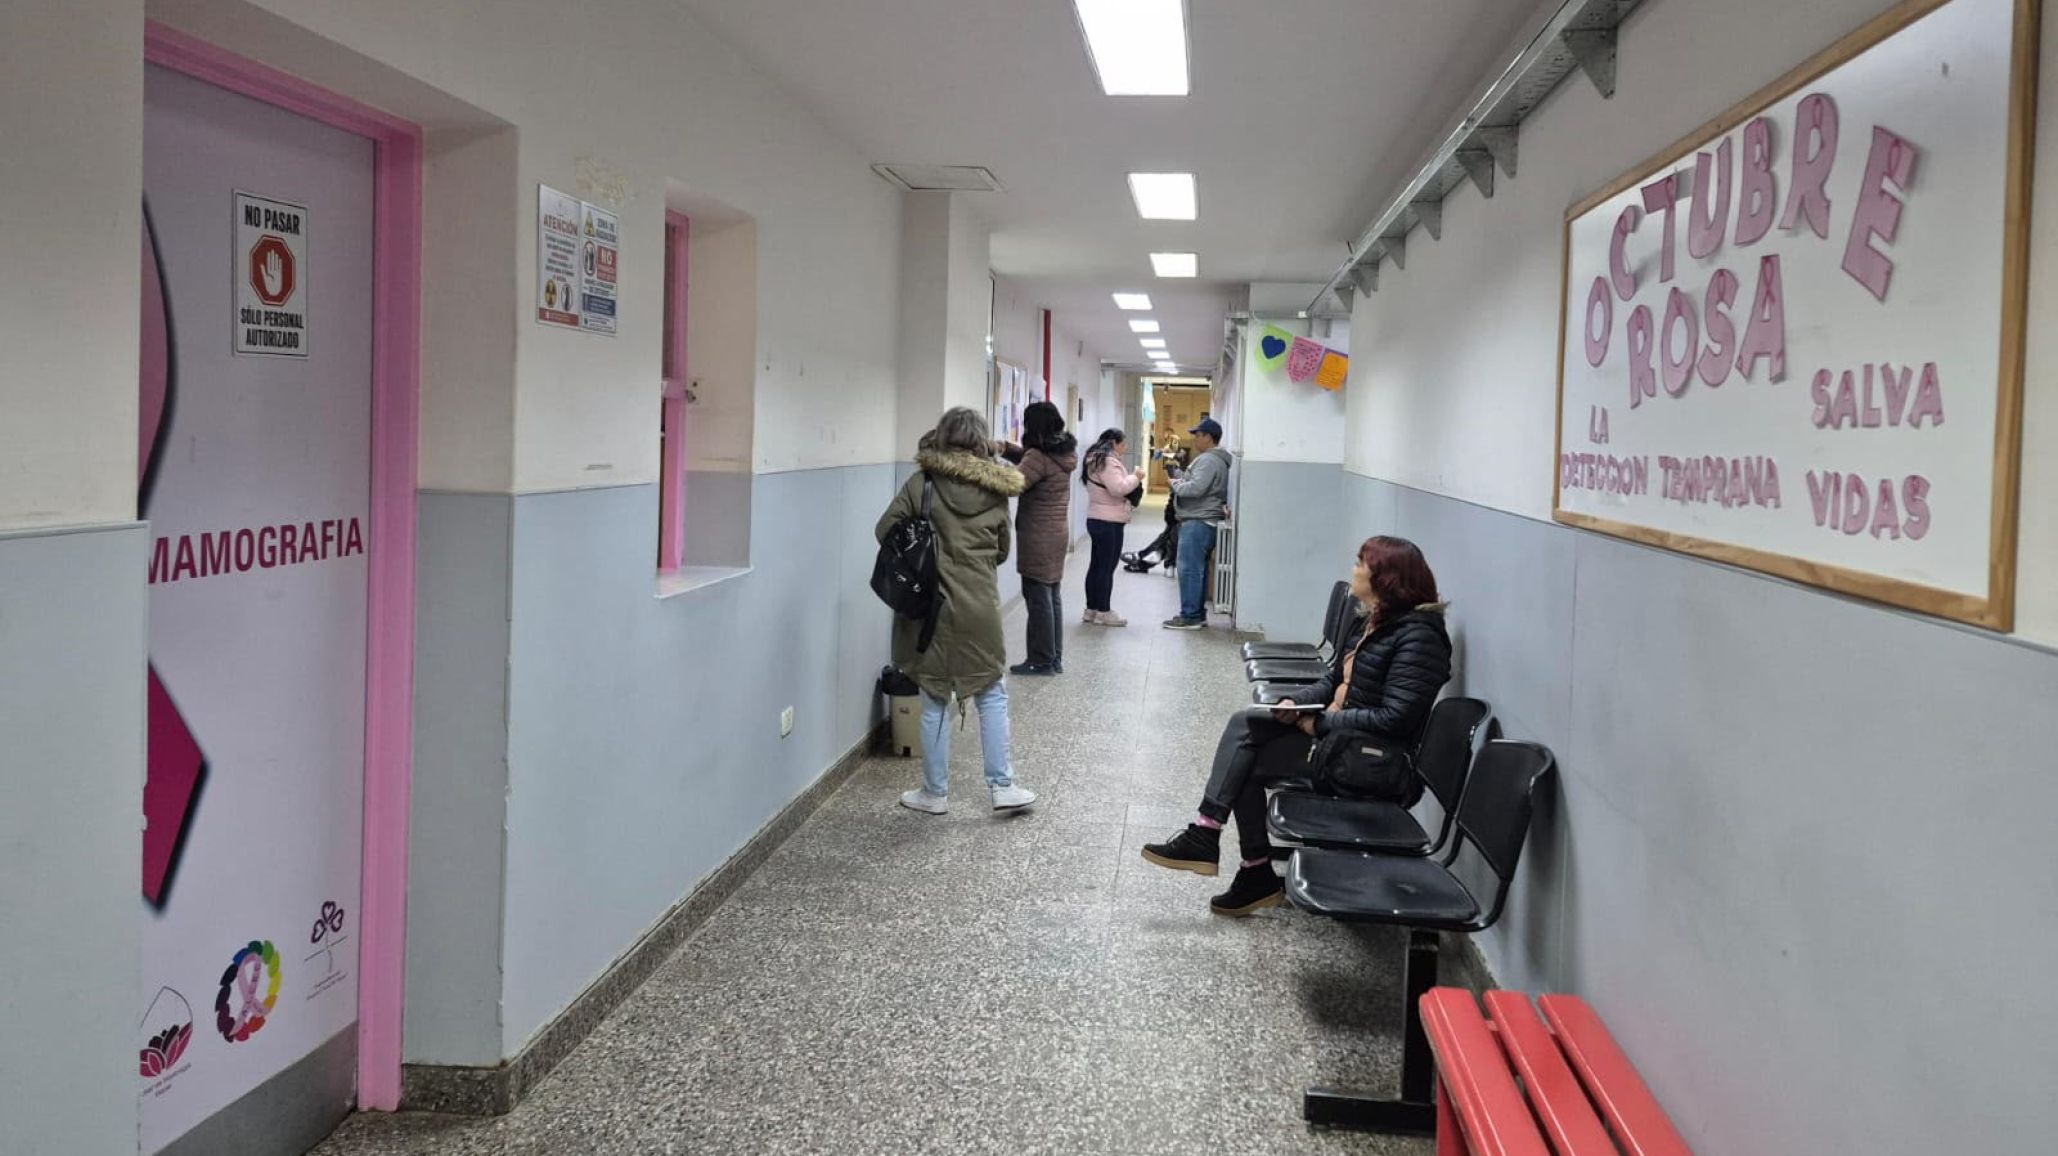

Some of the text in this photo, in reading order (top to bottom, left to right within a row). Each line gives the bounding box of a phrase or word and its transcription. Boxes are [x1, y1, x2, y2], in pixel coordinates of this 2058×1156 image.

[244, 204, 301, 235] NO PASAR
[1585, 92, 1917, 368] OCTUBRE
[601, 248, 613, 265] NO
[246, 328, 300, 349] AUTORIZADO
[264, 311, 304, 329] PERSONAL
[1626, 254, 1787, 409] ROSA
[1589, 404, 1609, 443] LA
[1811, 362, 1945, 430] SALVA
[1561, 452, 1781, 508] DETECCION TEMPRANA
[1805, 469, 1931, 541] VIDAS
[148, 517, 363, 584] MAMOGRAFIA
